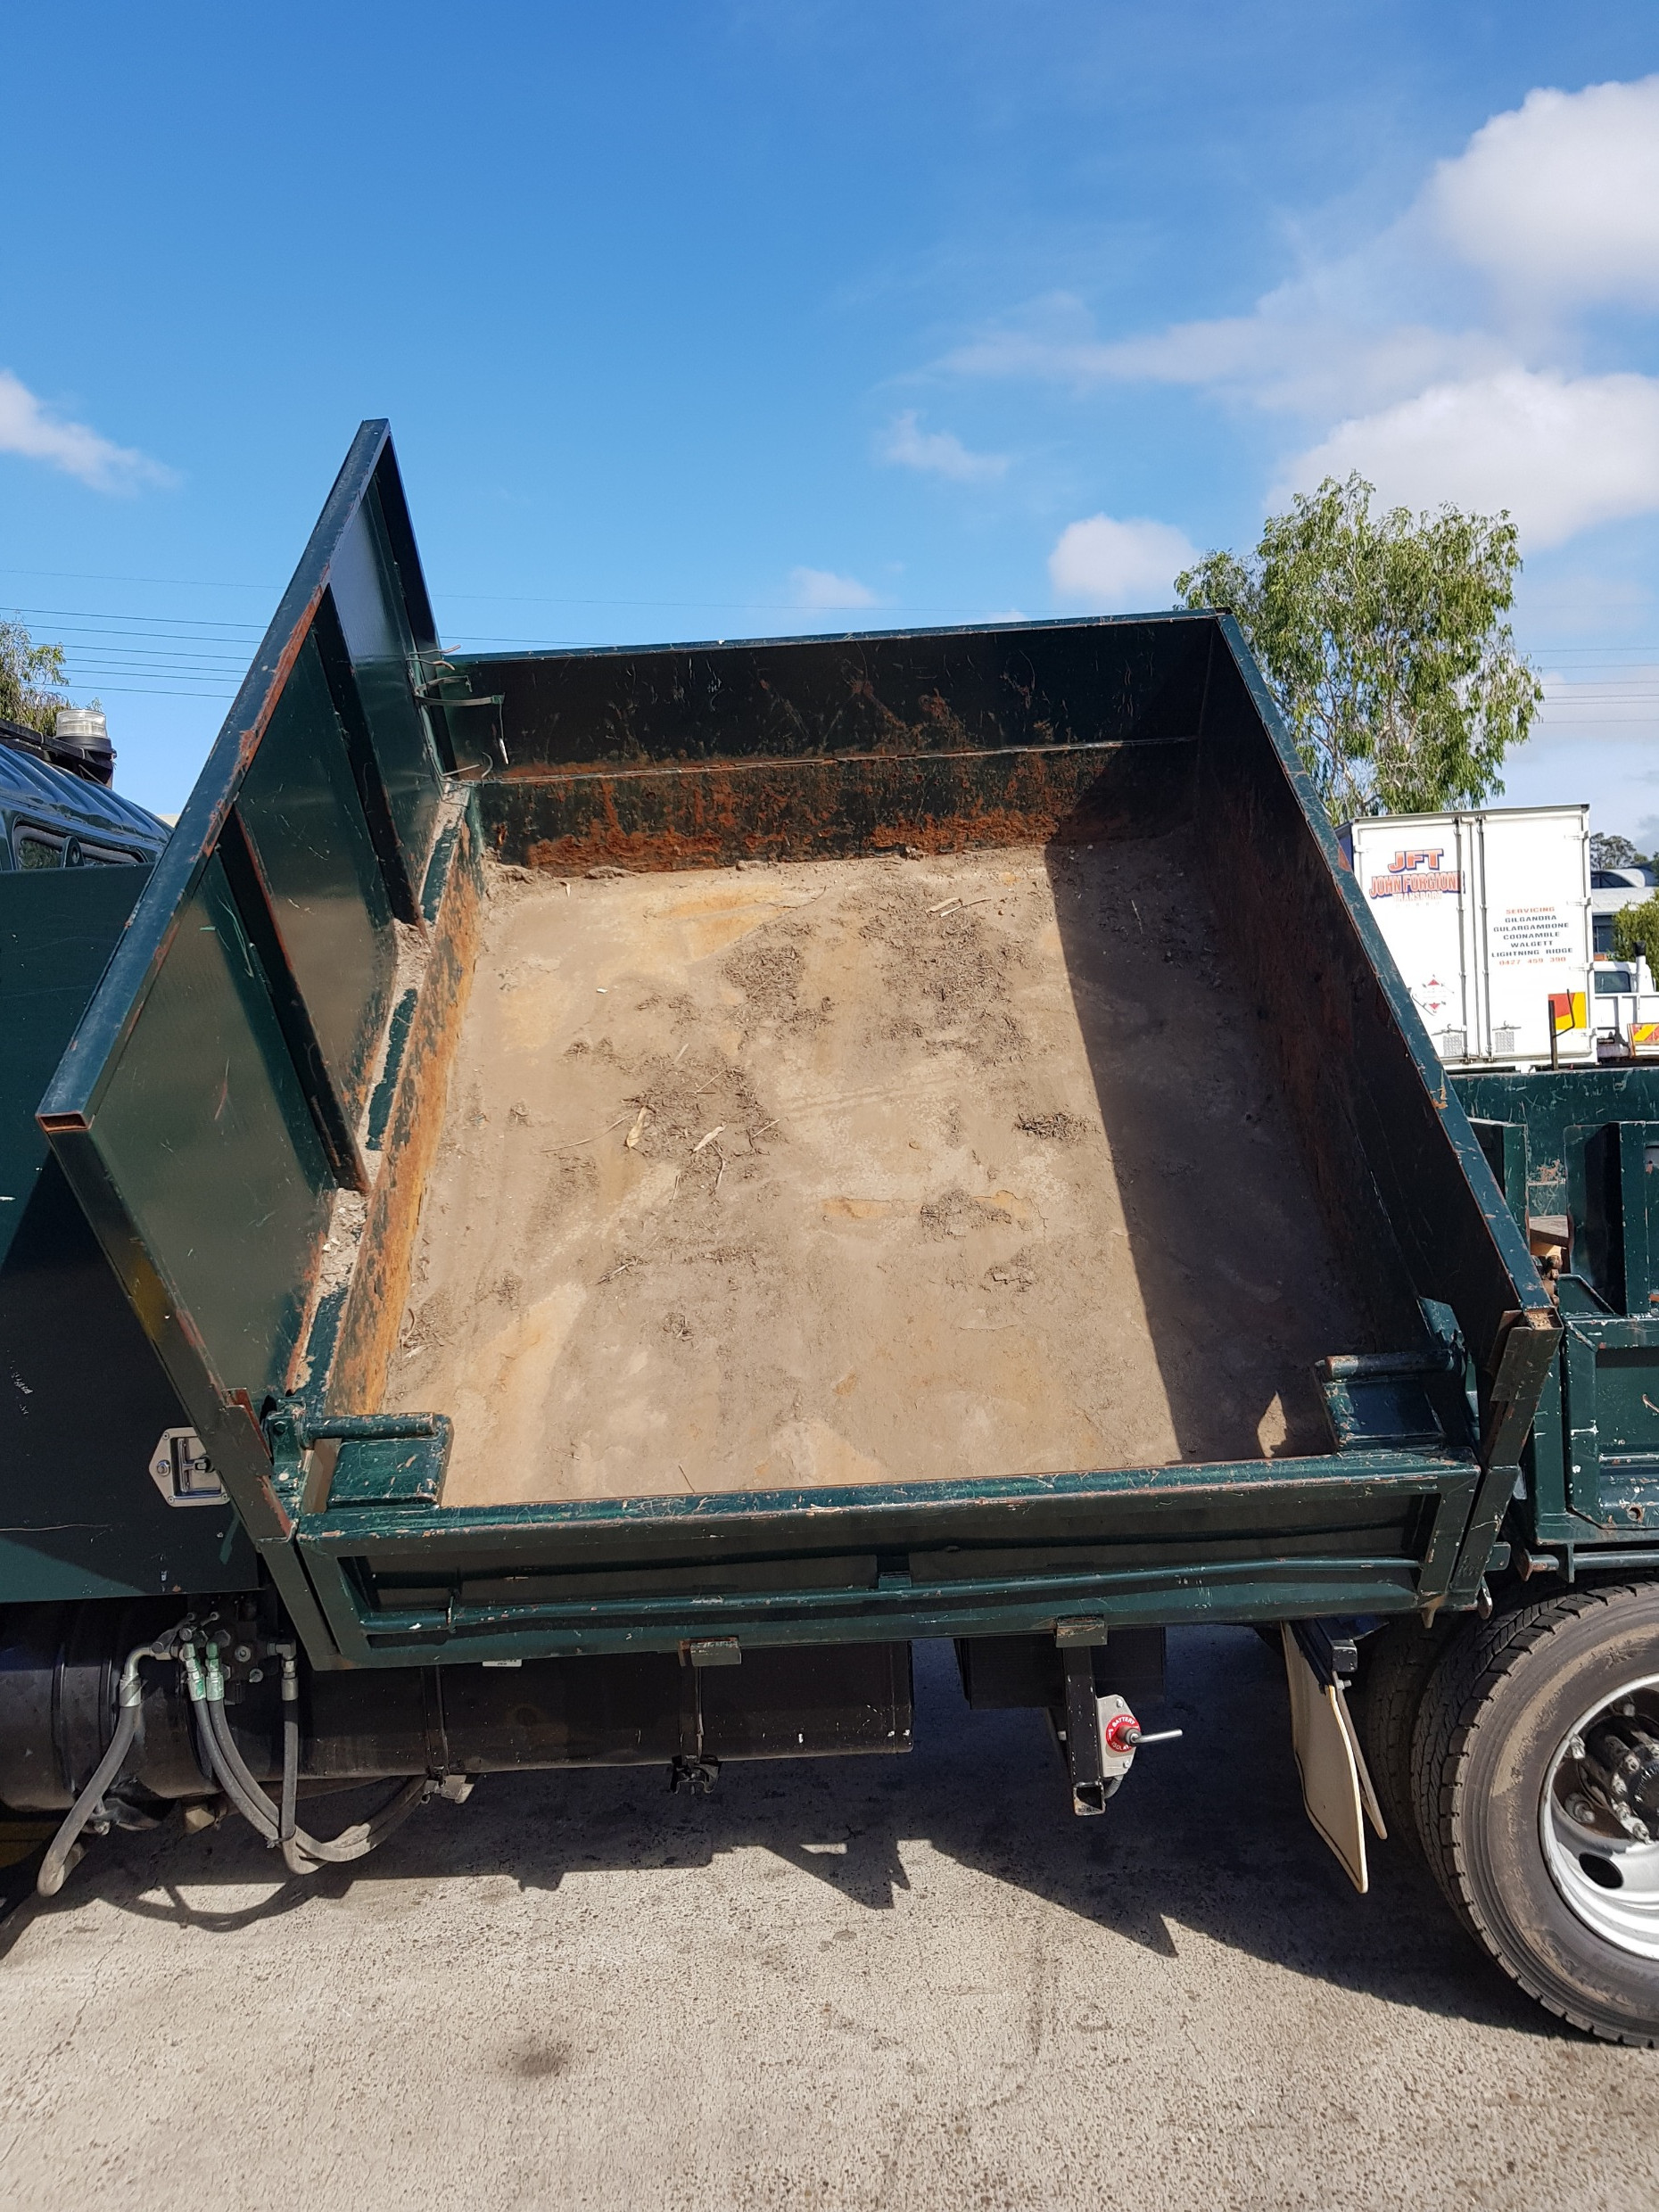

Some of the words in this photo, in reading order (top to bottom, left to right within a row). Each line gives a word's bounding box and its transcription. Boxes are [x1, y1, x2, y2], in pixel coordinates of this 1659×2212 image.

[1388, 848, 1444, 873] JFT
[1369, 875, 1402, 899] JOHN
[1403, 871, 1465, 895] FORGION
[1392, 891, 1442, 903] TRANSPORT
[1506, 906, 1556, 914] SERVICING
[1505, 915, 1556, 923] GILGANDRA
[1493, 922, 1569, 932] GULARGAMBONE
[1503, 931, 1560, 940] COONAMBLE
[1511, 940, 1553, 948] WALGETT
[1491, 950, 1539, 958] LIGHTNING
[1112, 1717, 1135, 1727] BATTERY
